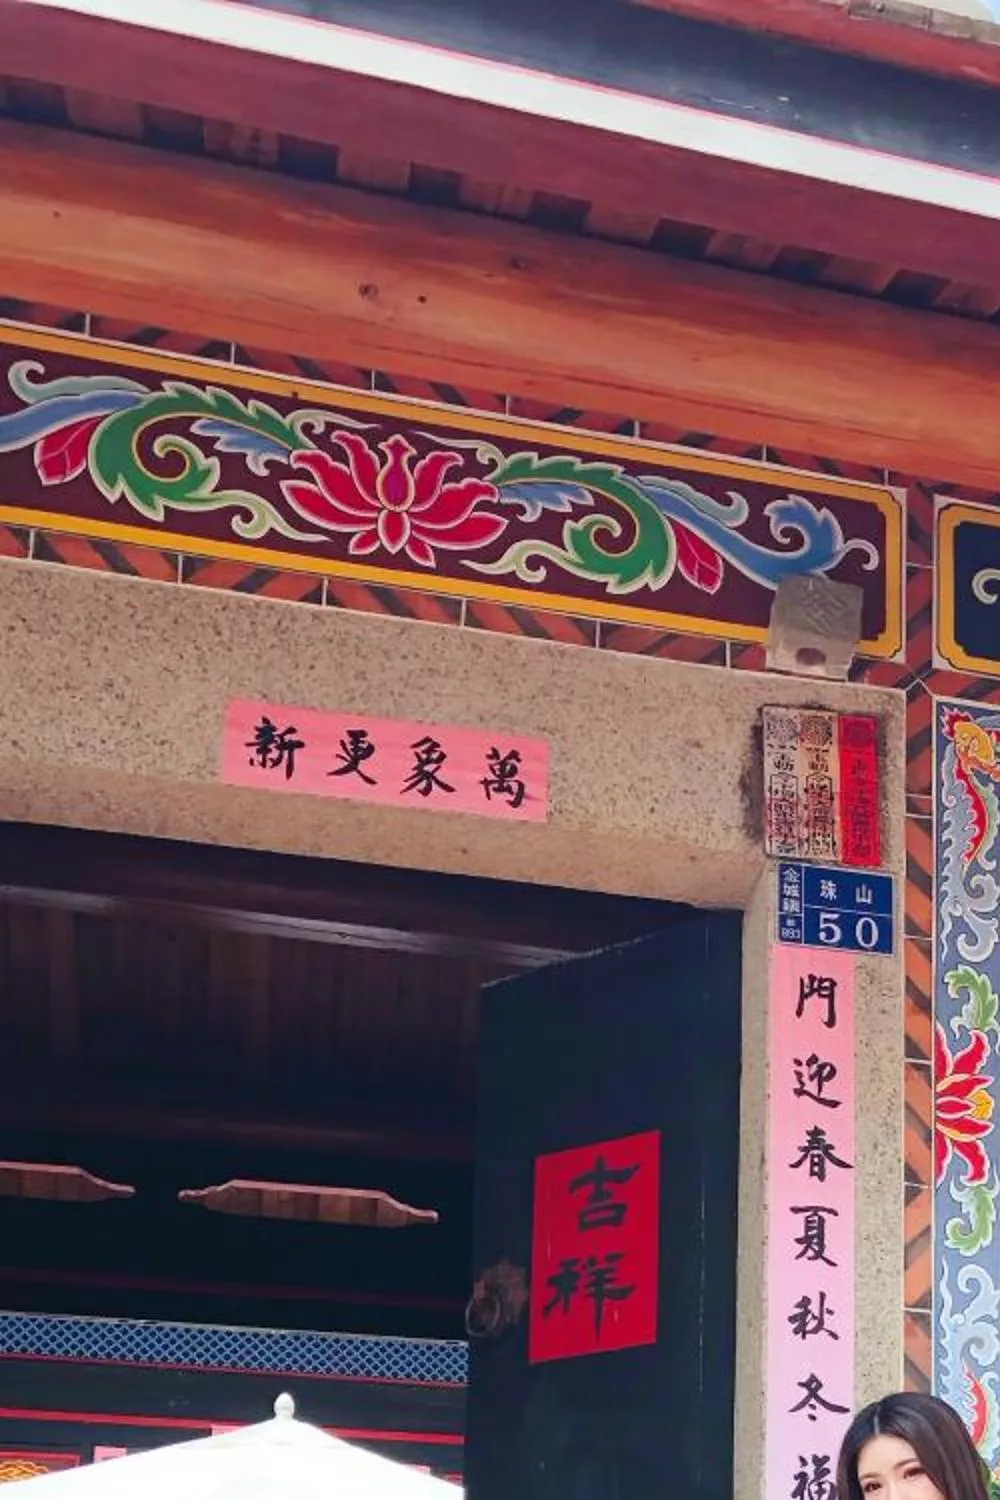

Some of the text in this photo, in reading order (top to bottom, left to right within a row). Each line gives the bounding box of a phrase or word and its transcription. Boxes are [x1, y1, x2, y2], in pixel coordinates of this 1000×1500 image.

[819, 879, 873, 904] 珠山
[819, 911, 879, 948] 50
[542, 1154, 641, 1345] 吉祥
